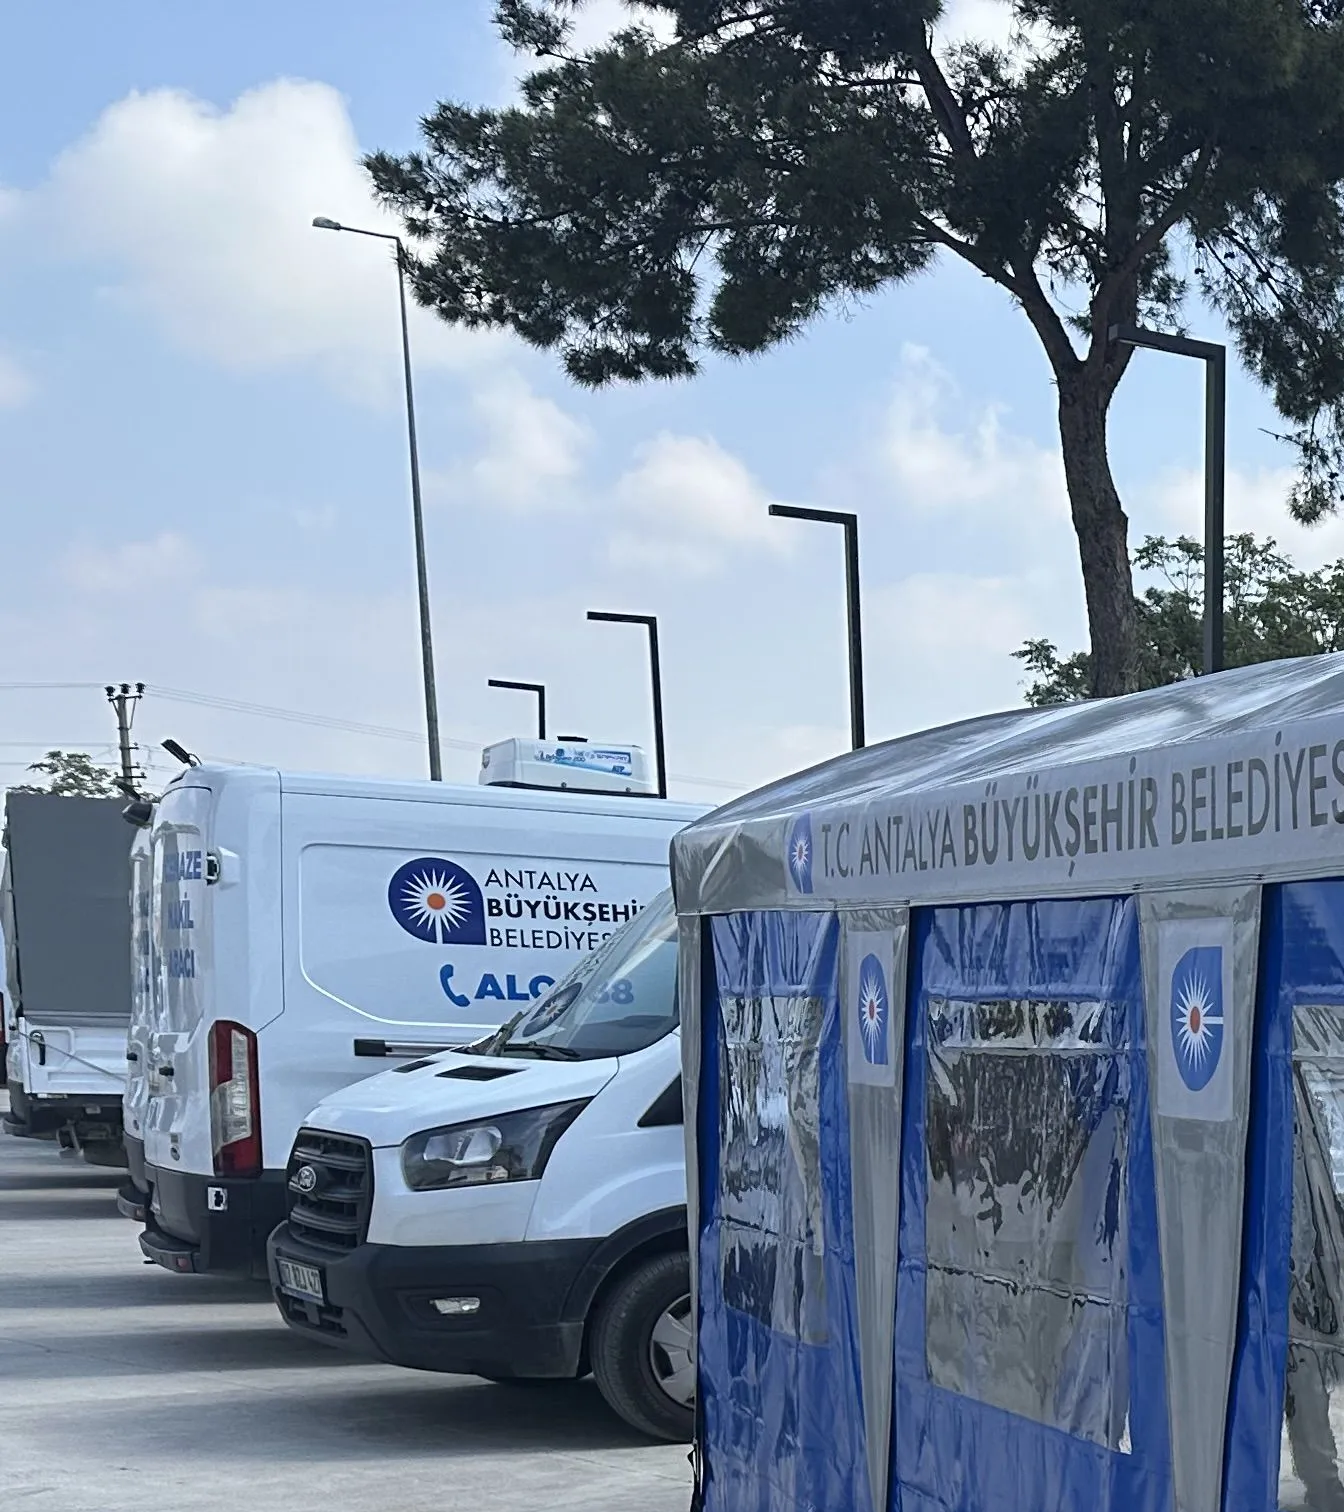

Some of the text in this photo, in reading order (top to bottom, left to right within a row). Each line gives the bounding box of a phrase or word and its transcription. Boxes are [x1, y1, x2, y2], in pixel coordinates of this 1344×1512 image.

[821, 821, 854, 879] T.C.
[858, 807, 958, 877] ANTALYA
[962, 756, 1161, 878] BÜYÜKŞEHİR
[484, 868, 599, 893] ANTALYA
[487, 893, 648, 927] BÜYÜKŞEHİ
[489, 925, 612, 951] BELEDİYE
